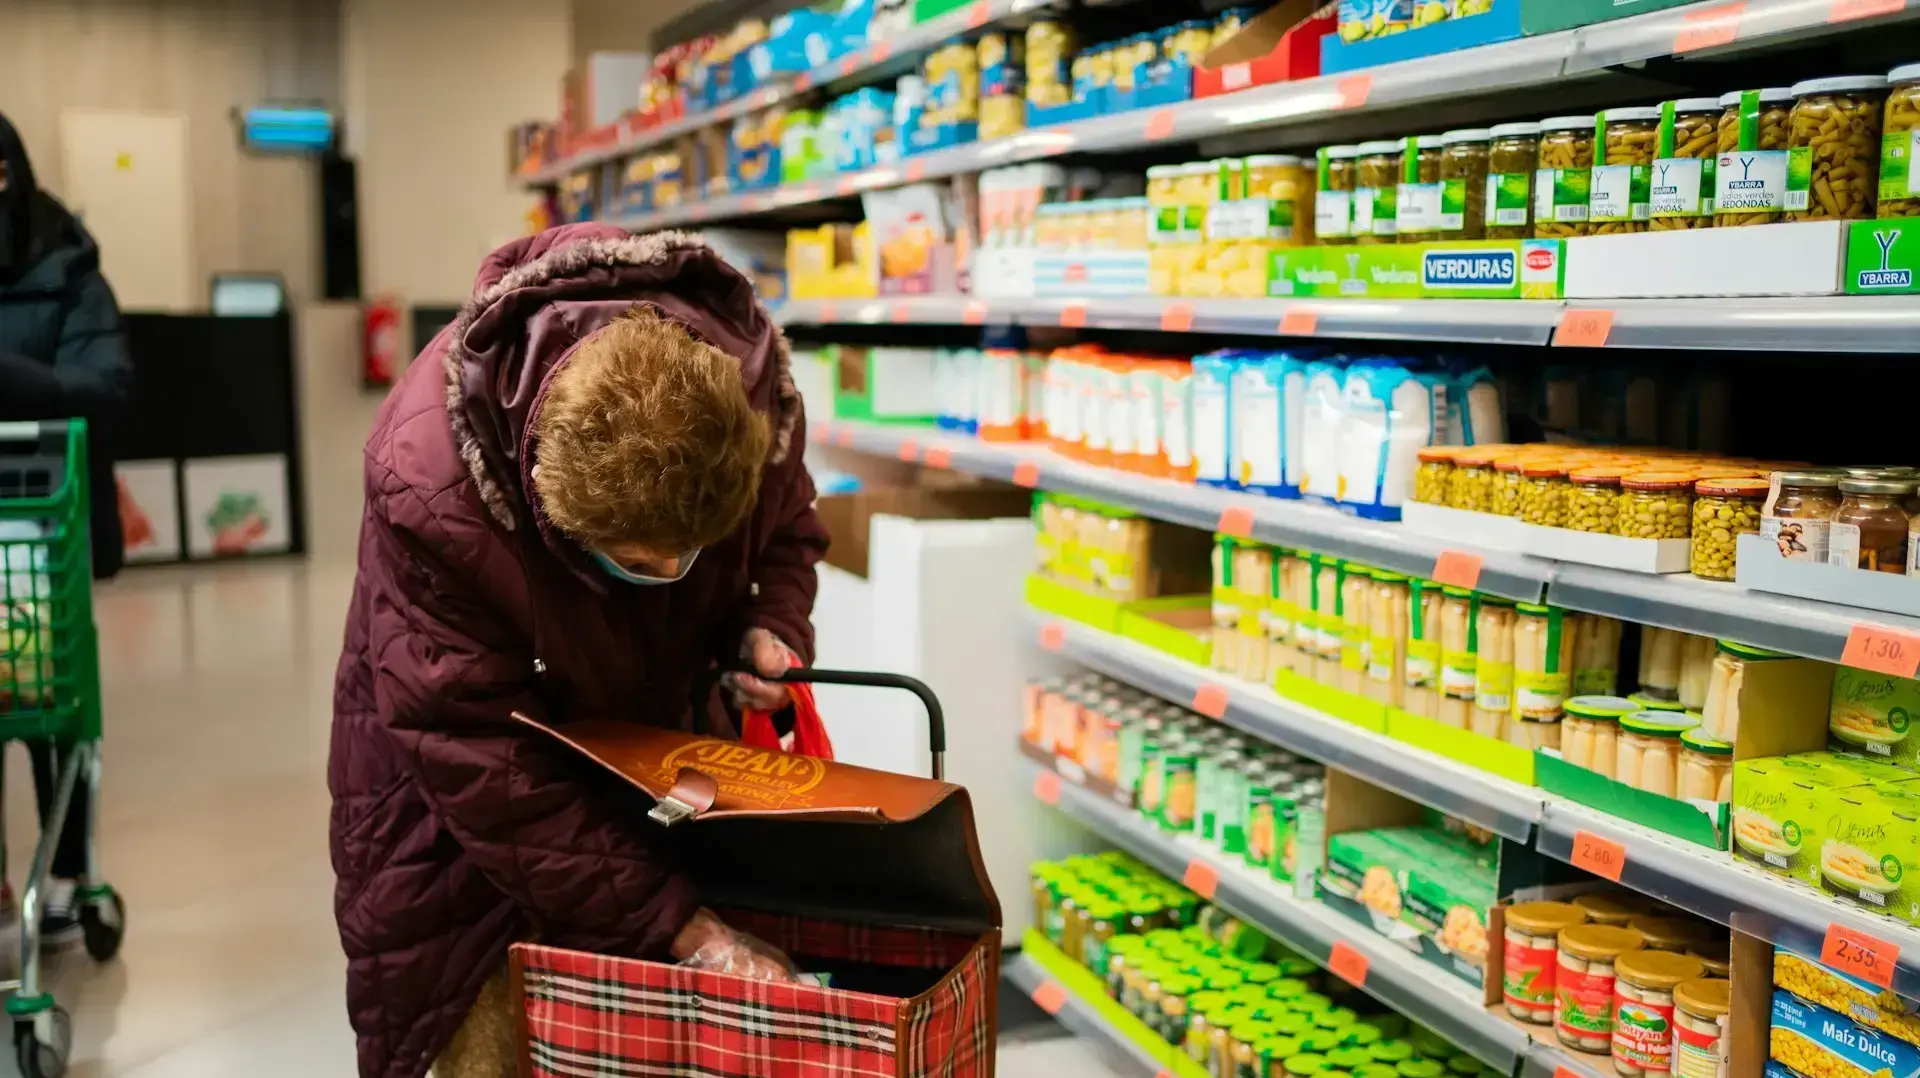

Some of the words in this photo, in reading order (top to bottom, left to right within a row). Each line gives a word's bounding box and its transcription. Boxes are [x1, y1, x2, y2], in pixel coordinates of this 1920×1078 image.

[1730, 181, 1763, 189] YBARRA
[1745, 189, 1776, 199] verdes
[1722, 199, 1771, 209] REDONDAS
[1876, 231, 1898, 270] Y
[1426, 258, 1513, 279] VERDURAS
[1862, 271, 1909, 285] YBARRA
[740, 772, 800, 789] TROLLEY
[1822, 1020, 1855, 1048] Maíz
[1858, 1035, 1897, 1066] Dulce
